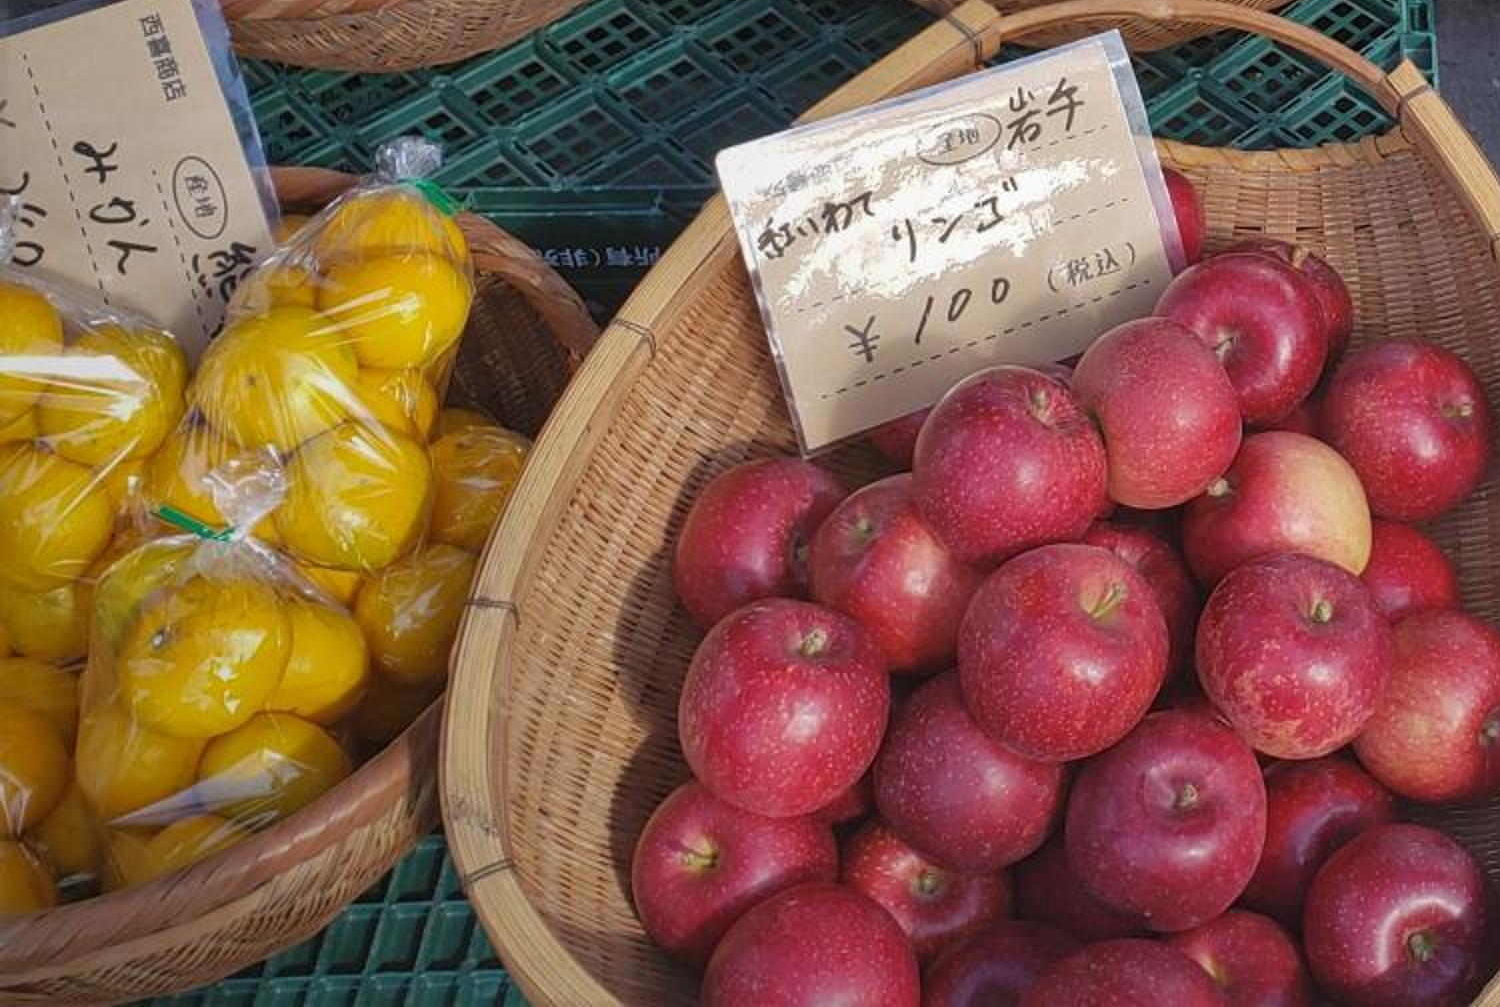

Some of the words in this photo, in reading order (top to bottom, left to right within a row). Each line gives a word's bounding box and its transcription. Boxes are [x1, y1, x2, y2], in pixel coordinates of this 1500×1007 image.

[139, 11, 187, 103] 西喜商店
[184, 174, 219, 219] 産地
[72, 140, 158, 275] みかん
[890, 178, 1019, 263] リンゴ
[914, 277, 1011, 345] 100
[1046, 241, 1137, 293] (税込)
